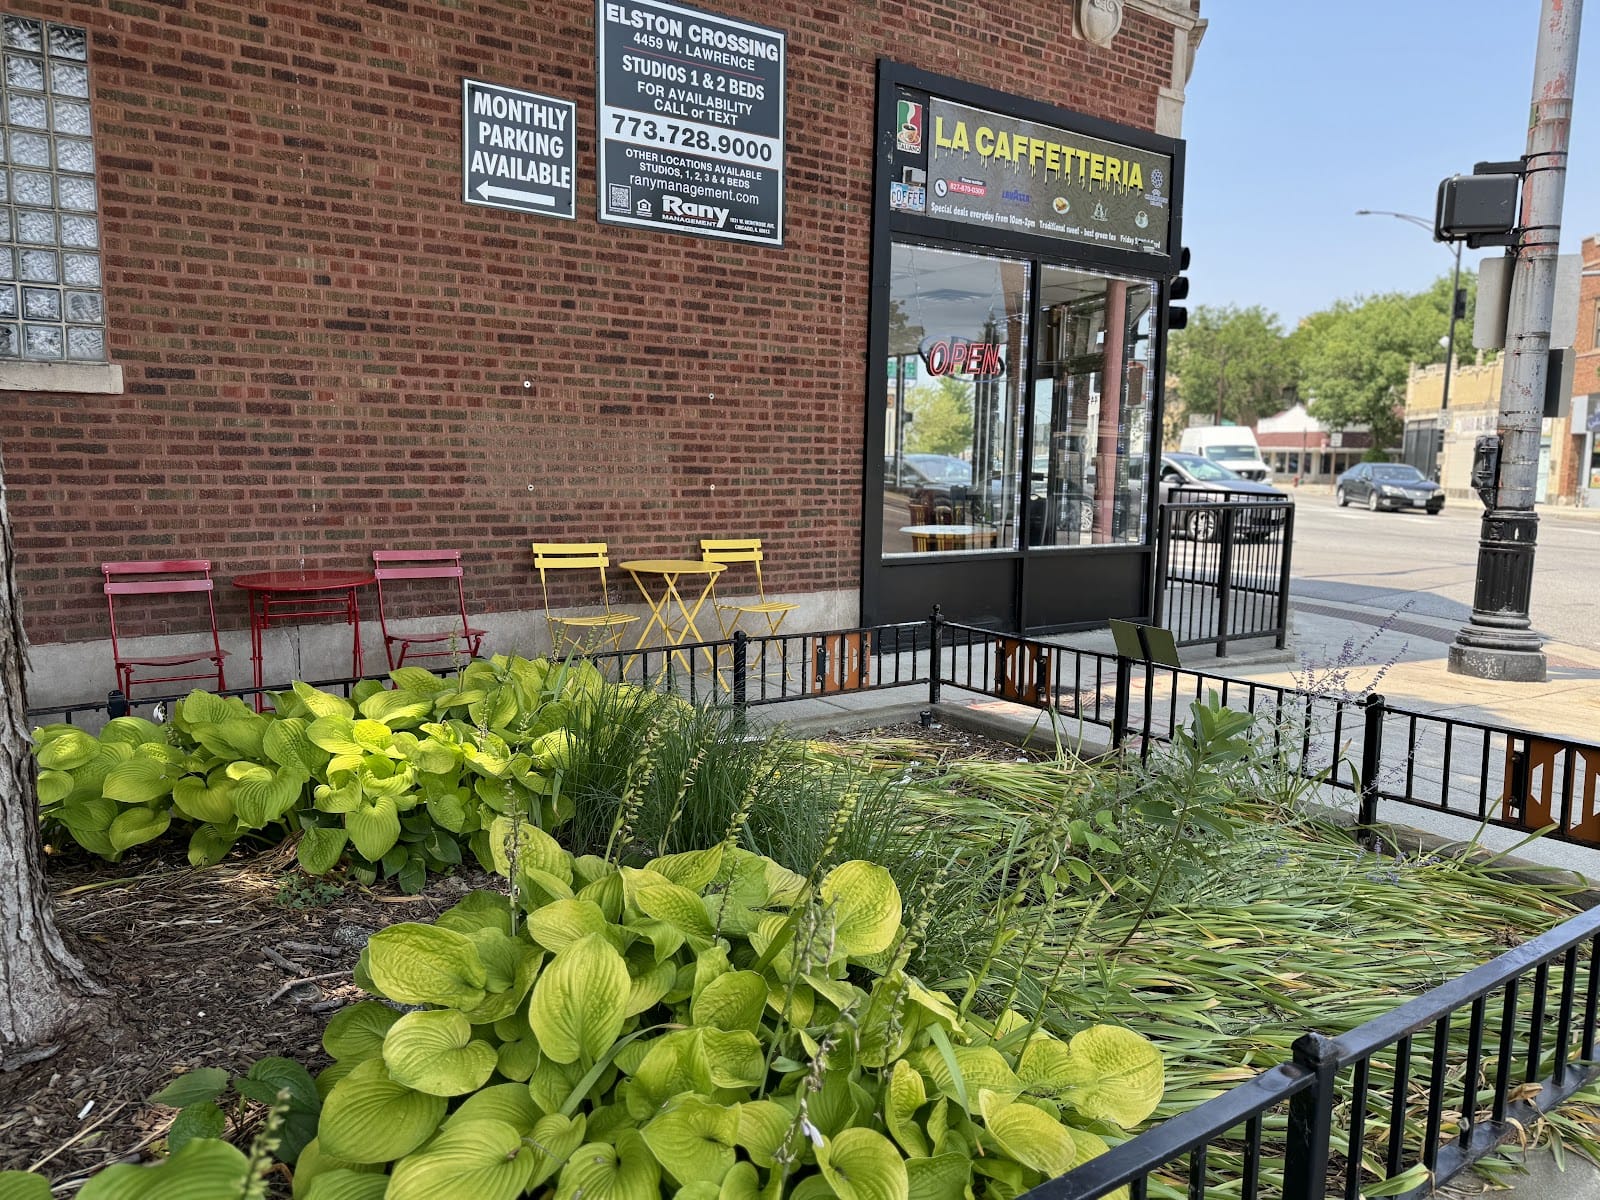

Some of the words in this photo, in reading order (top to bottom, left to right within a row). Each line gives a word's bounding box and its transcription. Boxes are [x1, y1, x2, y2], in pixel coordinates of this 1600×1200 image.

[606, 3, 683, 38] ELSTON
[688, 25, 779, 62] CROSSING
[633, 32, 663, 50] 4459
[666, 40, 682, 54] W.
[685, 44, 755, 71] LAWRENCE
[622, 54, 686, 84] STUDIOS
[690, 70, 699, 86] 1
[702, 73, 714, 90] &
[716, 75, 726, 92] 2
[729, 78, 765, 101] BEDS
[473, 91, 568, 132] MONTHLY
[637, 81, 665, 98] FOR
[668, 87, 753, 116] AVAILABILITY
[654, 98, 688, 116] CALL
[691, 108, 704, 119] or
[707, 109, 738, 126] TEXT
[479, 121, 564, 159] PARKING
[611, 113, 772, 162] 773.728.9000
[935, 115, 971, 157] LA
[975, 126, 1144, 193] CAFFETTERIA
[471, 150, 571, 189] AVAILABLE
[625, 147, 658, 162] OTHER
[660, 155, 713, 172] LOCATIONS
[714, 164, 762, 181] AVAILABLE
[639, 162, 683, 179] STUDIOS,
[685, 170, 693, 181] 1,
[694, 171, 703, 182] 2,
[704, 173, 710, 182] 3
[712, 174, 719, 184] &
[719, 175, 725, 185] 4
[727, 177, 750, 190] BEDS
[629, 174, 759, 205] ranymanagement.com
[892, 189, 924, 206] COFFEE
[662, 194, 730, 228] Rany
[662, 214, 719, 228] MANAGEMENT
[931, 202, 952, 214] Special
[953, 206, 968, 217] deals
[969, 210, 994, 223] everyday
[928, 340, 1001, 377] OPEN
